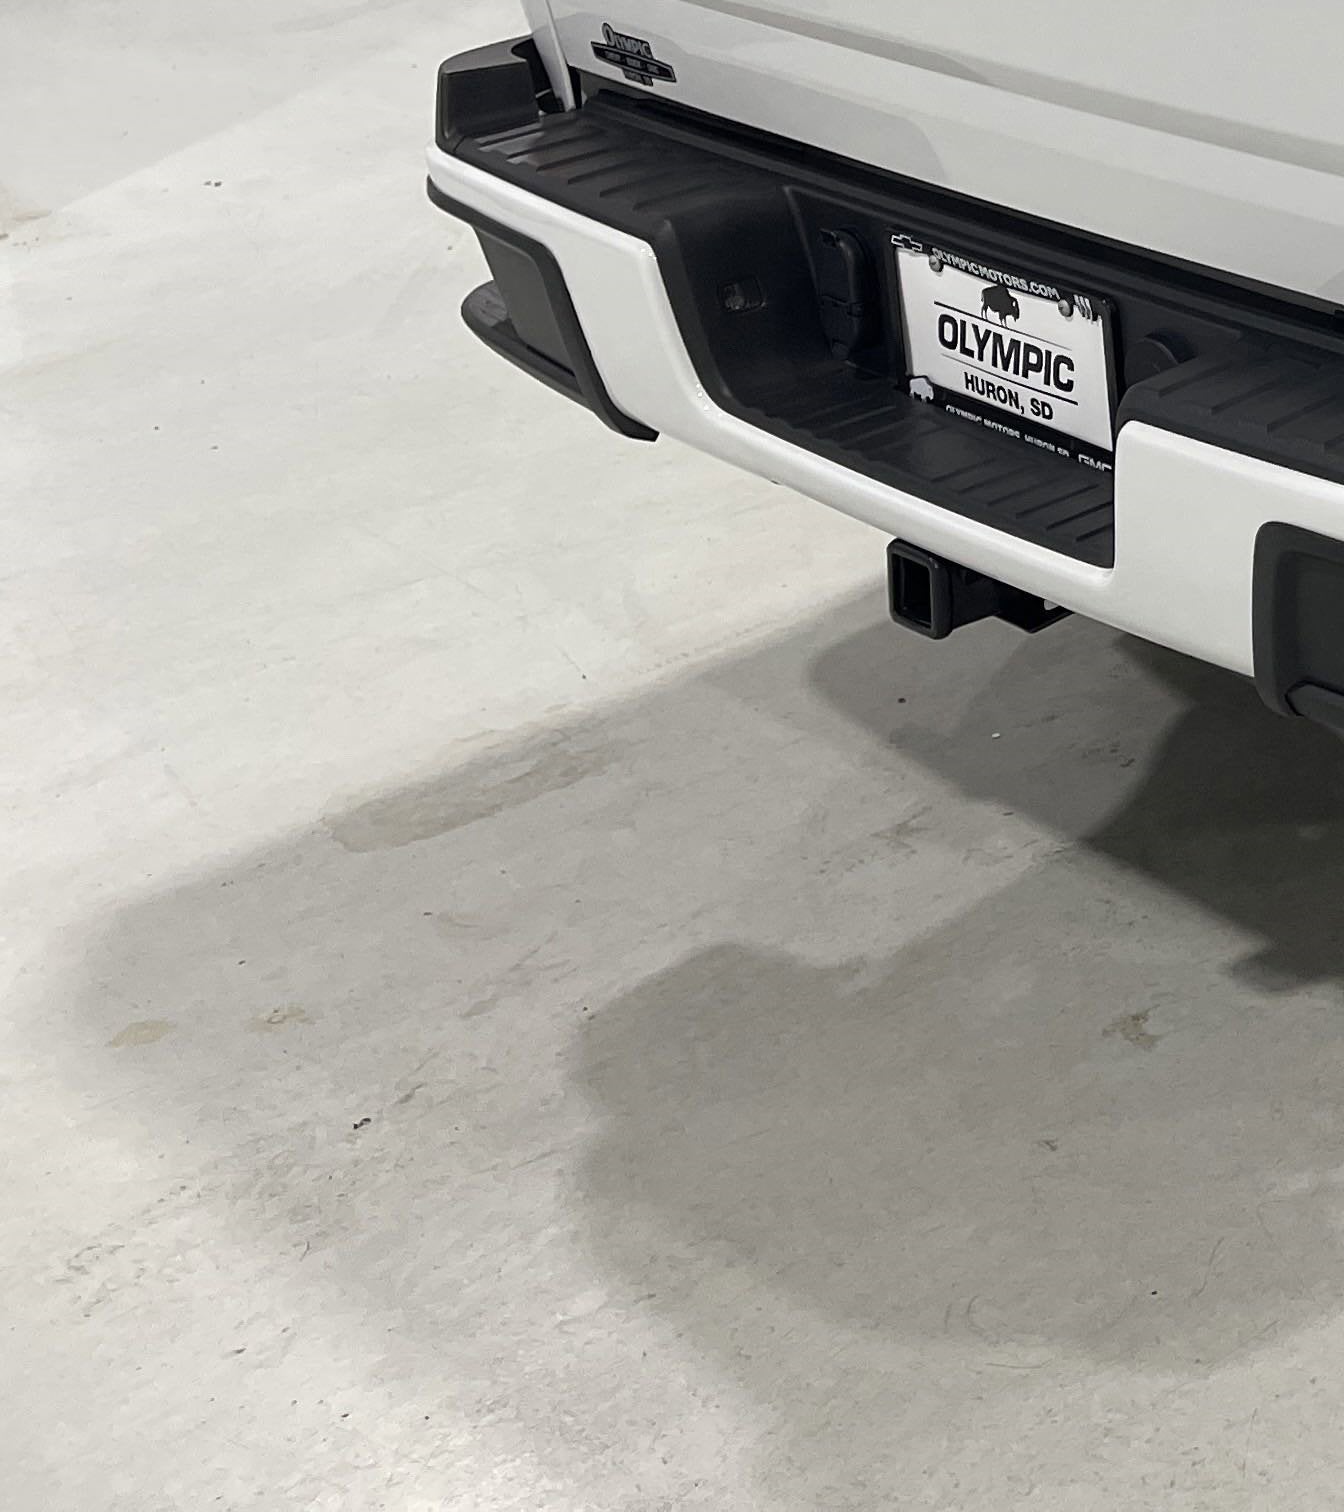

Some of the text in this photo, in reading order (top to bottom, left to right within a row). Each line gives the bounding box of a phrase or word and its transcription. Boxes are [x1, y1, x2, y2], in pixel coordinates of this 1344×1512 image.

[931, 247, 1062, 301] OLYMPICMOTORS.COM
[937, 313, 1075, 393] OLYMPIC
[963, 371, 1054, 420] HURON, SD
